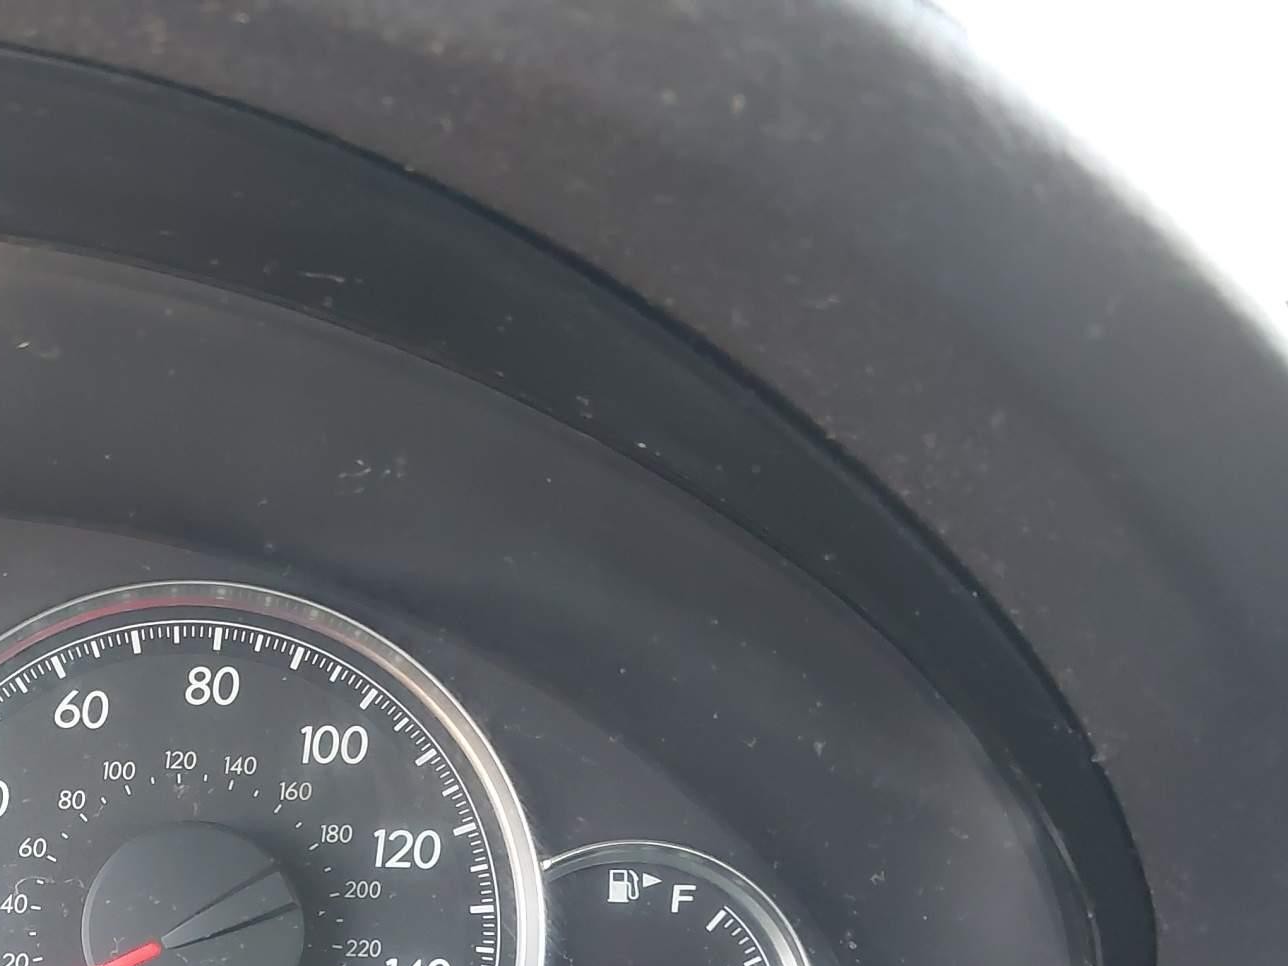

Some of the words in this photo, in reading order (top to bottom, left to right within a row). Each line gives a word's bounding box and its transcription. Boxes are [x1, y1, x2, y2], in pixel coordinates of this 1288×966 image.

[185, 666, 240, 706] 80
[54, 689, 109, 729] 60
[300, 725, 369, 765] 100
[165, 750, 197, 770] 120
[224, 756, 257, 775] 140
[103, 761, 136, 781] 100
[58, 789, 86, 810] 80
[279, 781, 312, 801] 160
[320, 824, 353, 844] 180
[18, 837, 47, 858] 60
[373, 829, 441, 870] 120
[344, 880, 382, 899] 200
[671, 884, 697, 913] F
[0, 893, 28, 914] 40
[345, 939, 382, 958] 220
